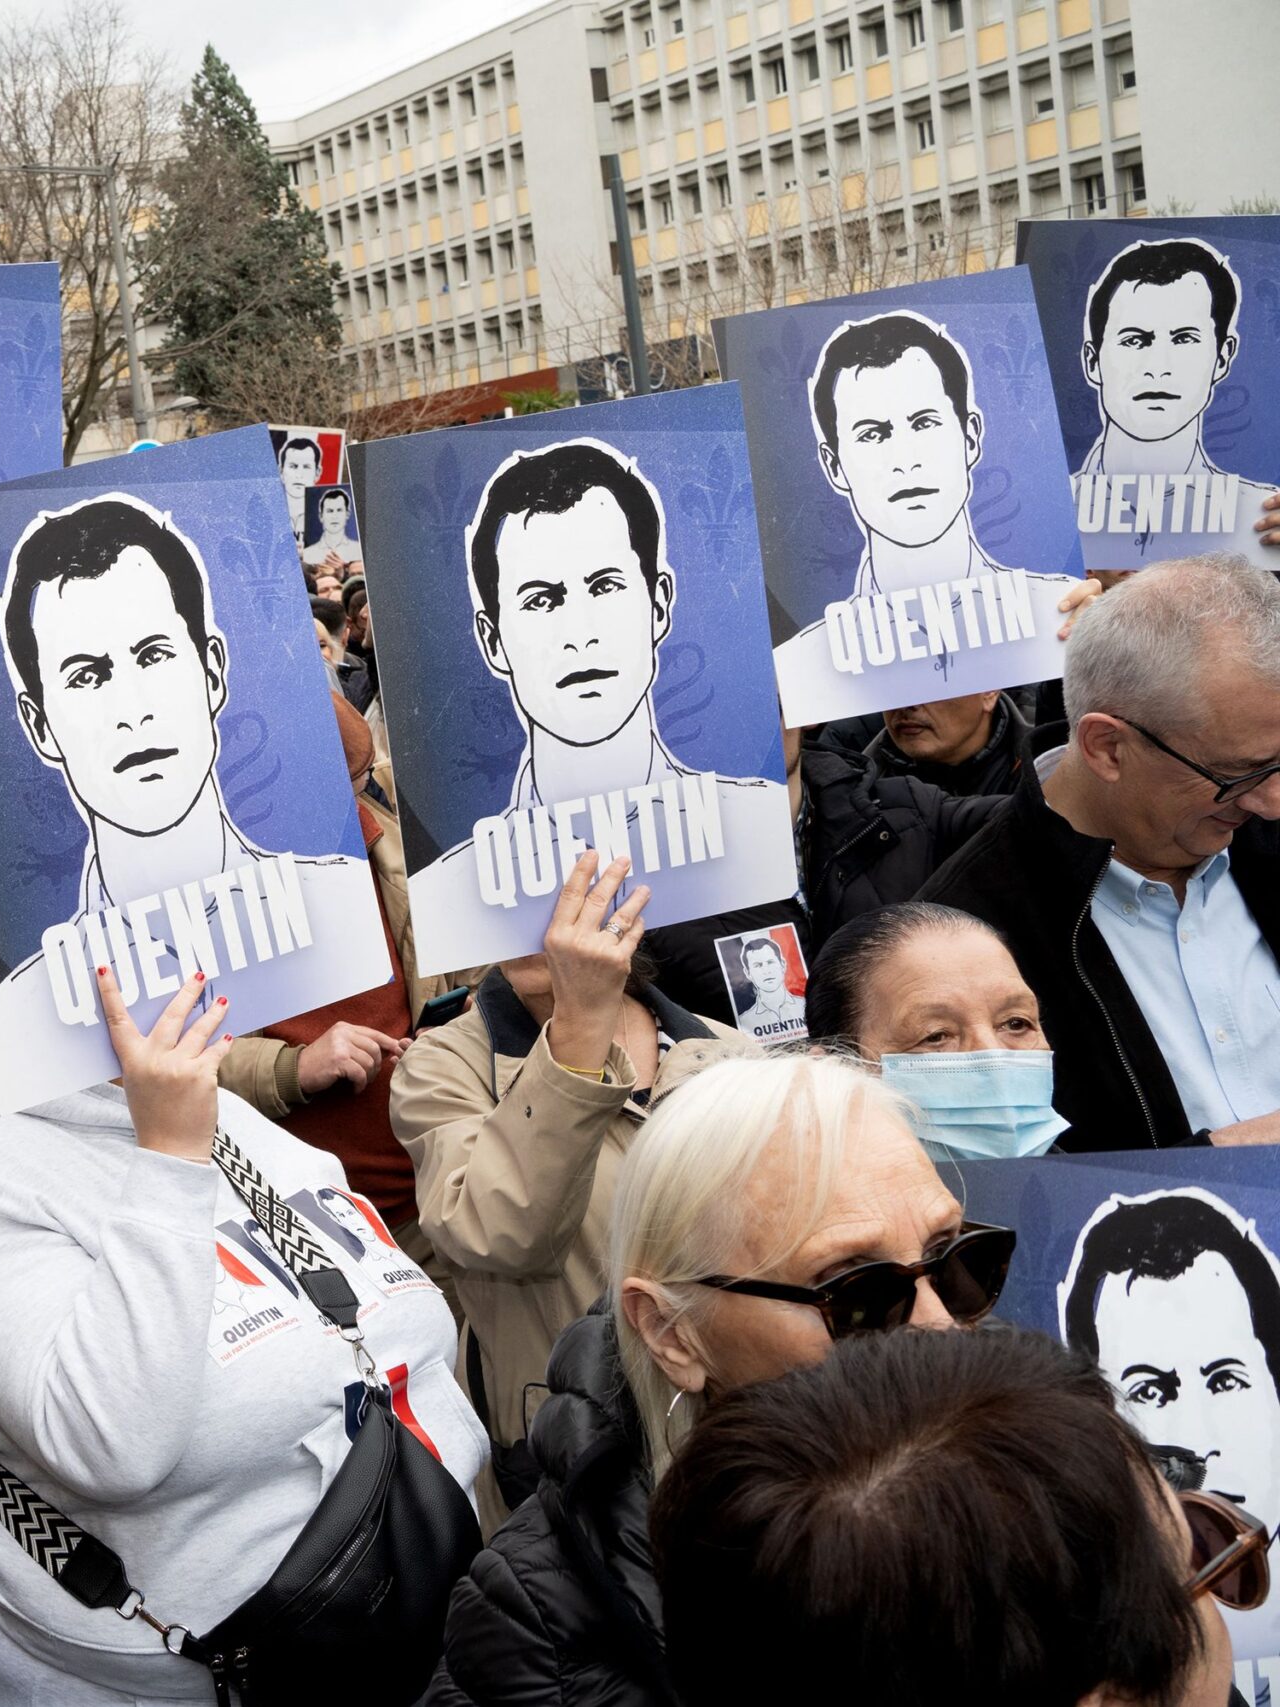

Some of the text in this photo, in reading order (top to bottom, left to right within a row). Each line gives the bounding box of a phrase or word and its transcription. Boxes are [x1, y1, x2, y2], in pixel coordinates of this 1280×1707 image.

[1069, 474, 1239, 533] UENTIN
[824, 568, 1037, 674] QUENTIN
[473, 771, 724, 908] QUENTIN
[41, 853, 313, 1027] QUENTIN
[383, 1270, 426, 1284] QUENTIN
[223, 1306, 284, 1343] QUENTIN
